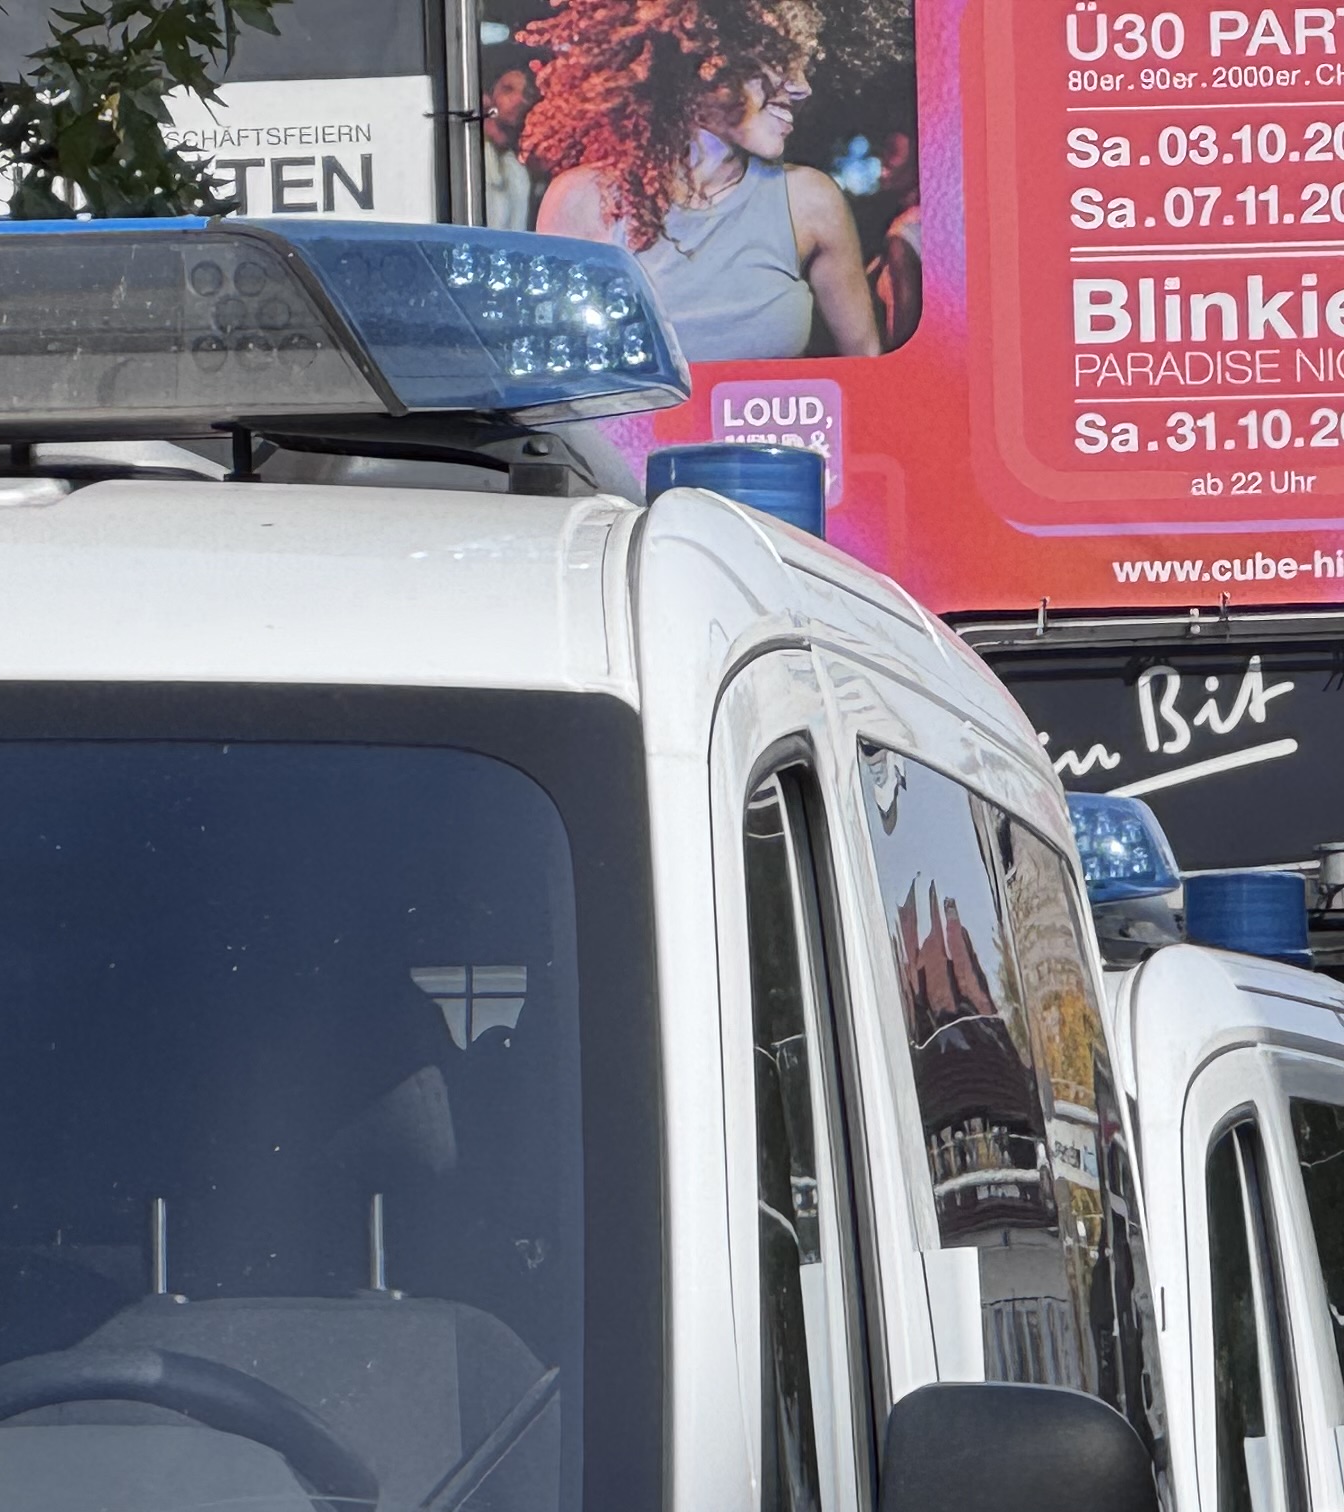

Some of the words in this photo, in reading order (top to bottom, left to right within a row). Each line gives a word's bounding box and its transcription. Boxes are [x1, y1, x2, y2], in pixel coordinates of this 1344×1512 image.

[1066, 2, 1185, 61] Ü30
[1209, 8, 1344, 57] PAR
[163, 124, 372, 150] SCHÄFTSFEIERN
[1076, 349, 1281, 387] PARADISE
[1296, 347, 1344, 383] NI
[724, 396, 833, 429] LOUD,
[1167, 408, 1344, 452] 31.10.2
[1191, 473, 1224, 496] ab
[1231, 472, 1262, 494] 22
[1270, 471, 1317, 494] Uhr
[1138, 655, 1295, 754] Bit
